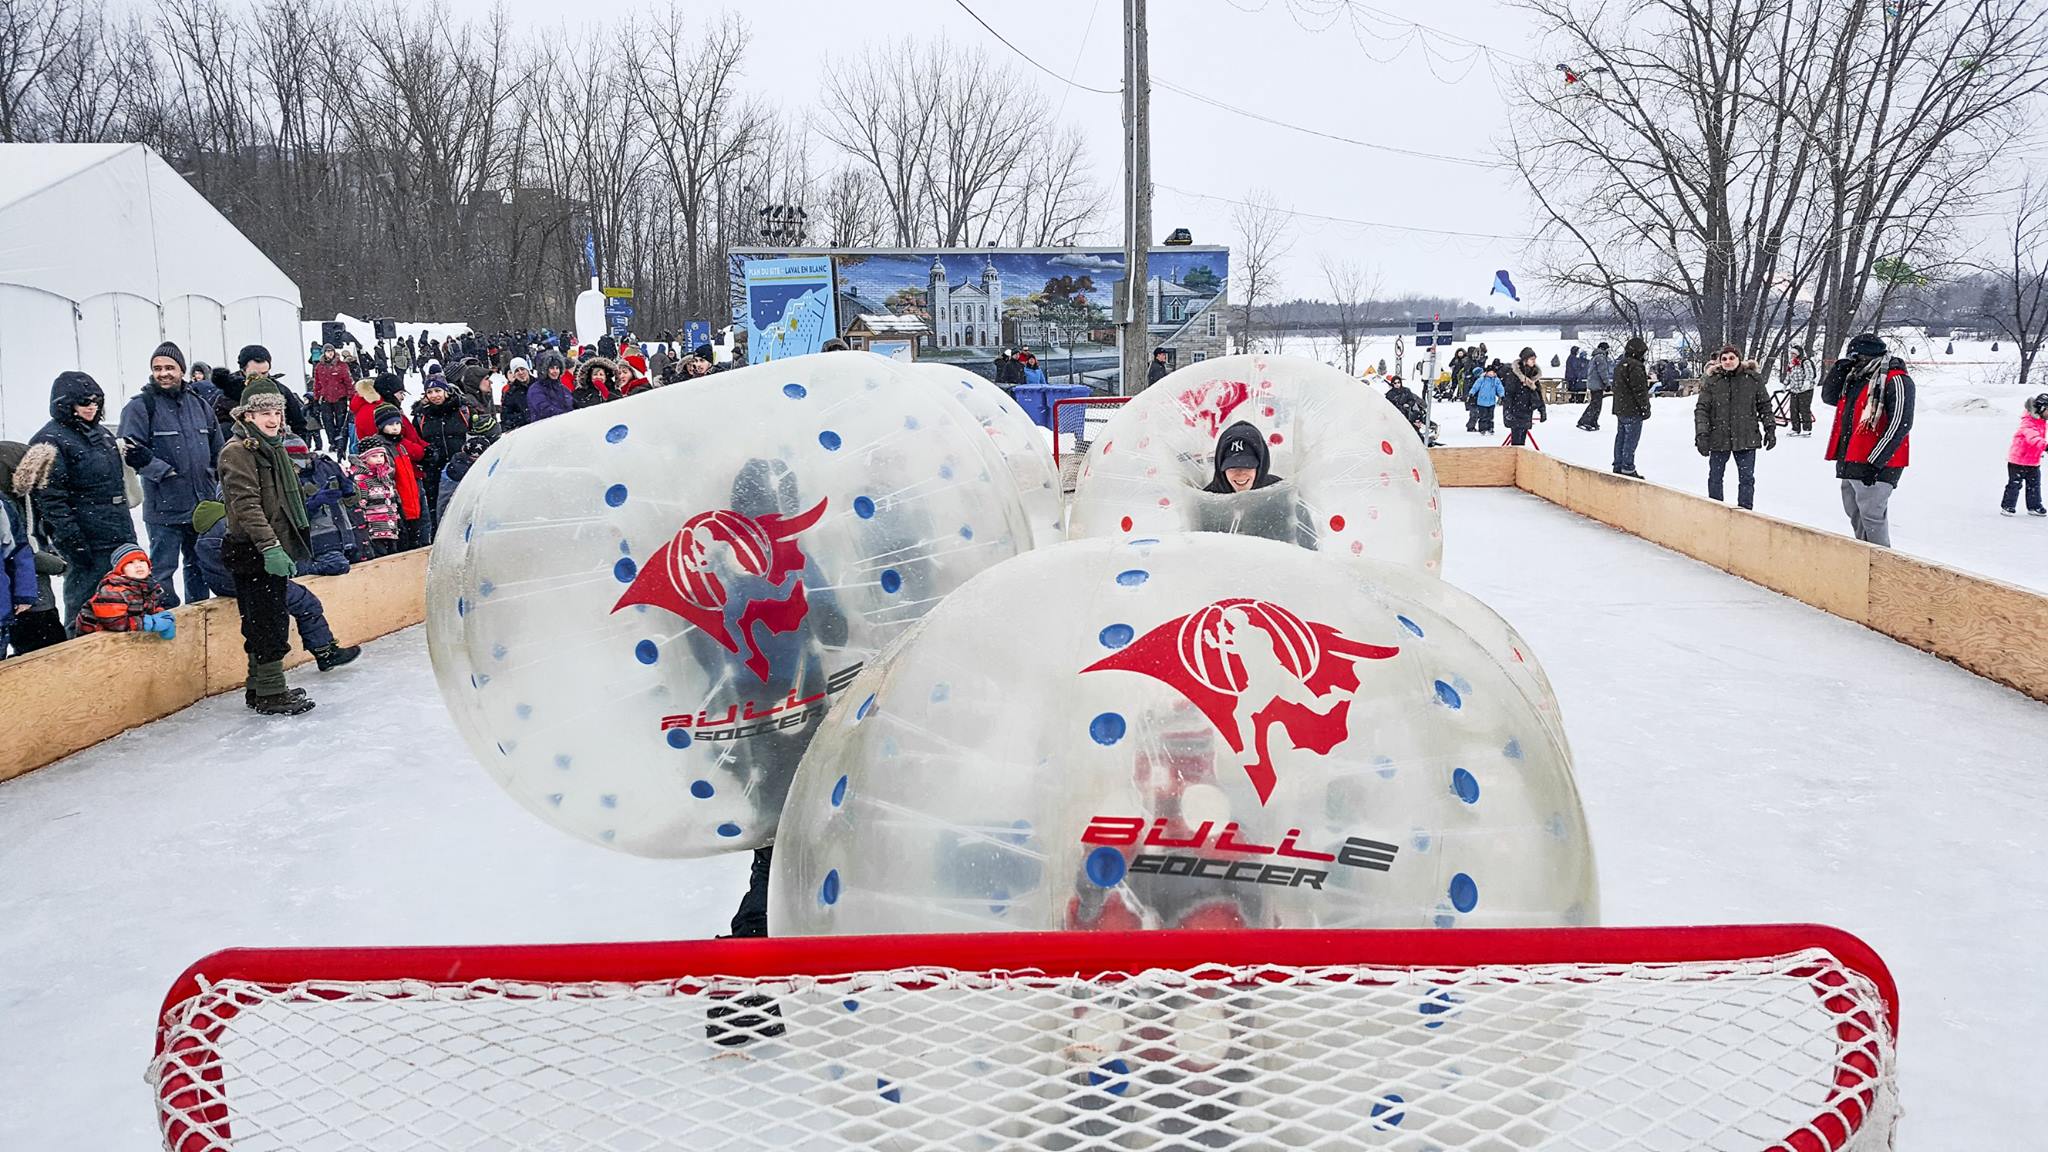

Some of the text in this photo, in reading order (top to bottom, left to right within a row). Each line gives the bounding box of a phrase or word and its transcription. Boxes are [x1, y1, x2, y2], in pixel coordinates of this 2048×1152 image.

[785, 266, 801, 274] LAVAL
[801, 265, 808, 273] EN
[809, 264, 827, 273] BLANC
[661, 661, 864, 730] BULLE
[694, 703, 828, 741] SOCCER
[1081, 816, 1399, 872] BULLE
[1128, 854, 1329, 890] SOCCER
